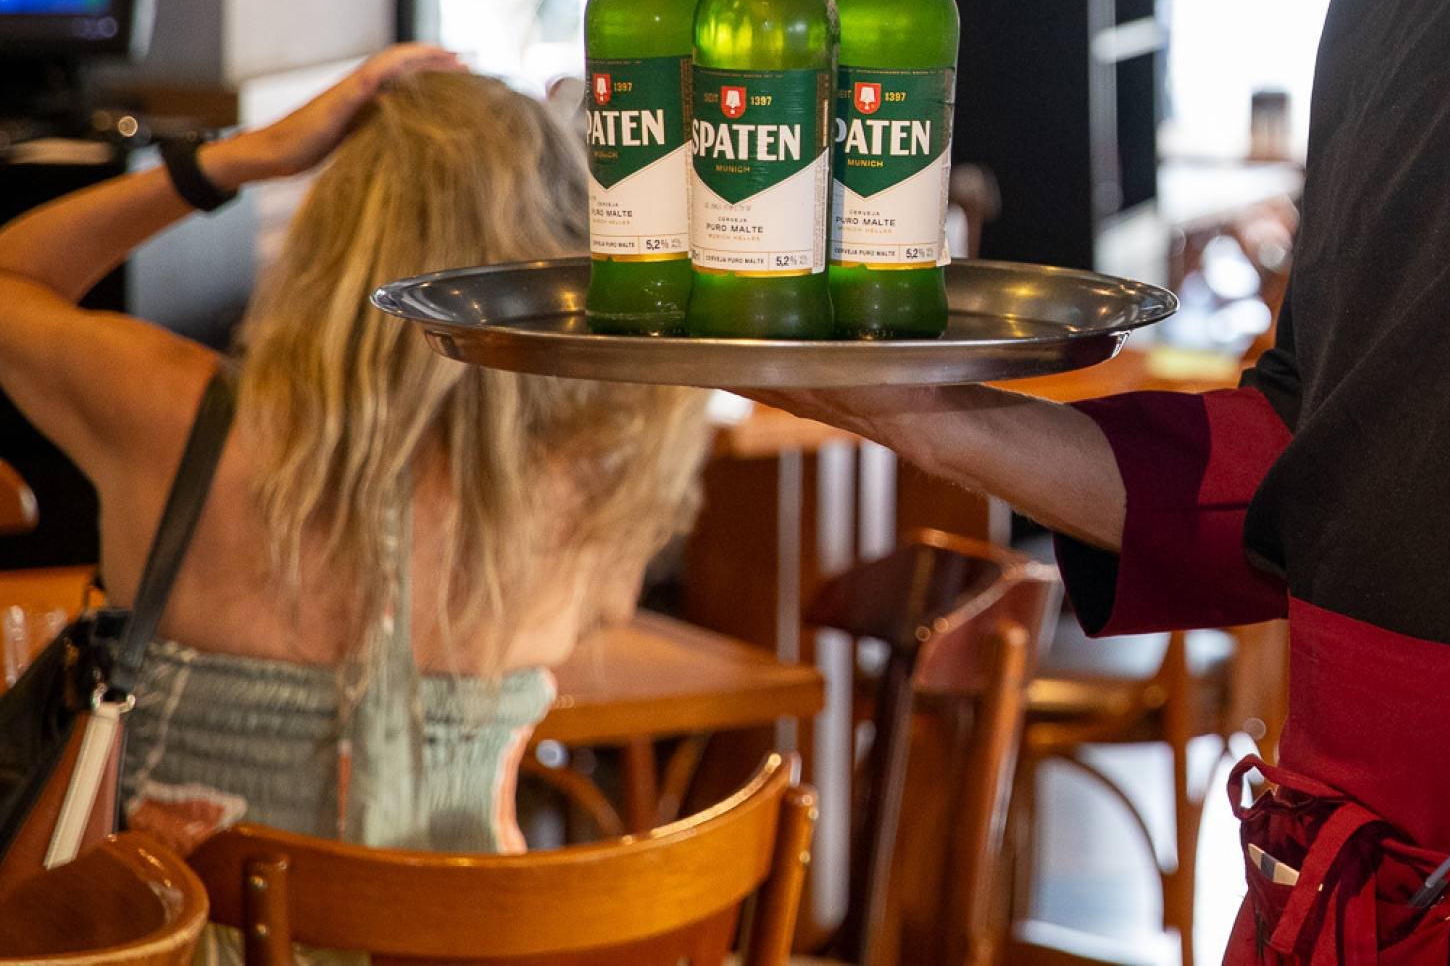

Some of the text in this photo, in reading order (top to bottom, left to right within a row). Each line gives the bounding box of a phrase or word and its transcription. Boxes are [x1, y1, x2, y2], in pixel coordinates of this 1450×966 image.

[613, 82, 633, 93] 1397
[750, 96, 772, 107] 1397
[885, 92, 907, 102] 1397
[692, 118, 801, 161] SPATEN
[847, 159, 884, 168] MUNICH
[715, 165, 751, 174] MUNICH
[605, 210, 633, 218] MALTE
[836, 216, 896, 227] PURO MALTE
[706, 222, 764, 234] PURO MALTE
[876, 249, 896, 258] MALTE
